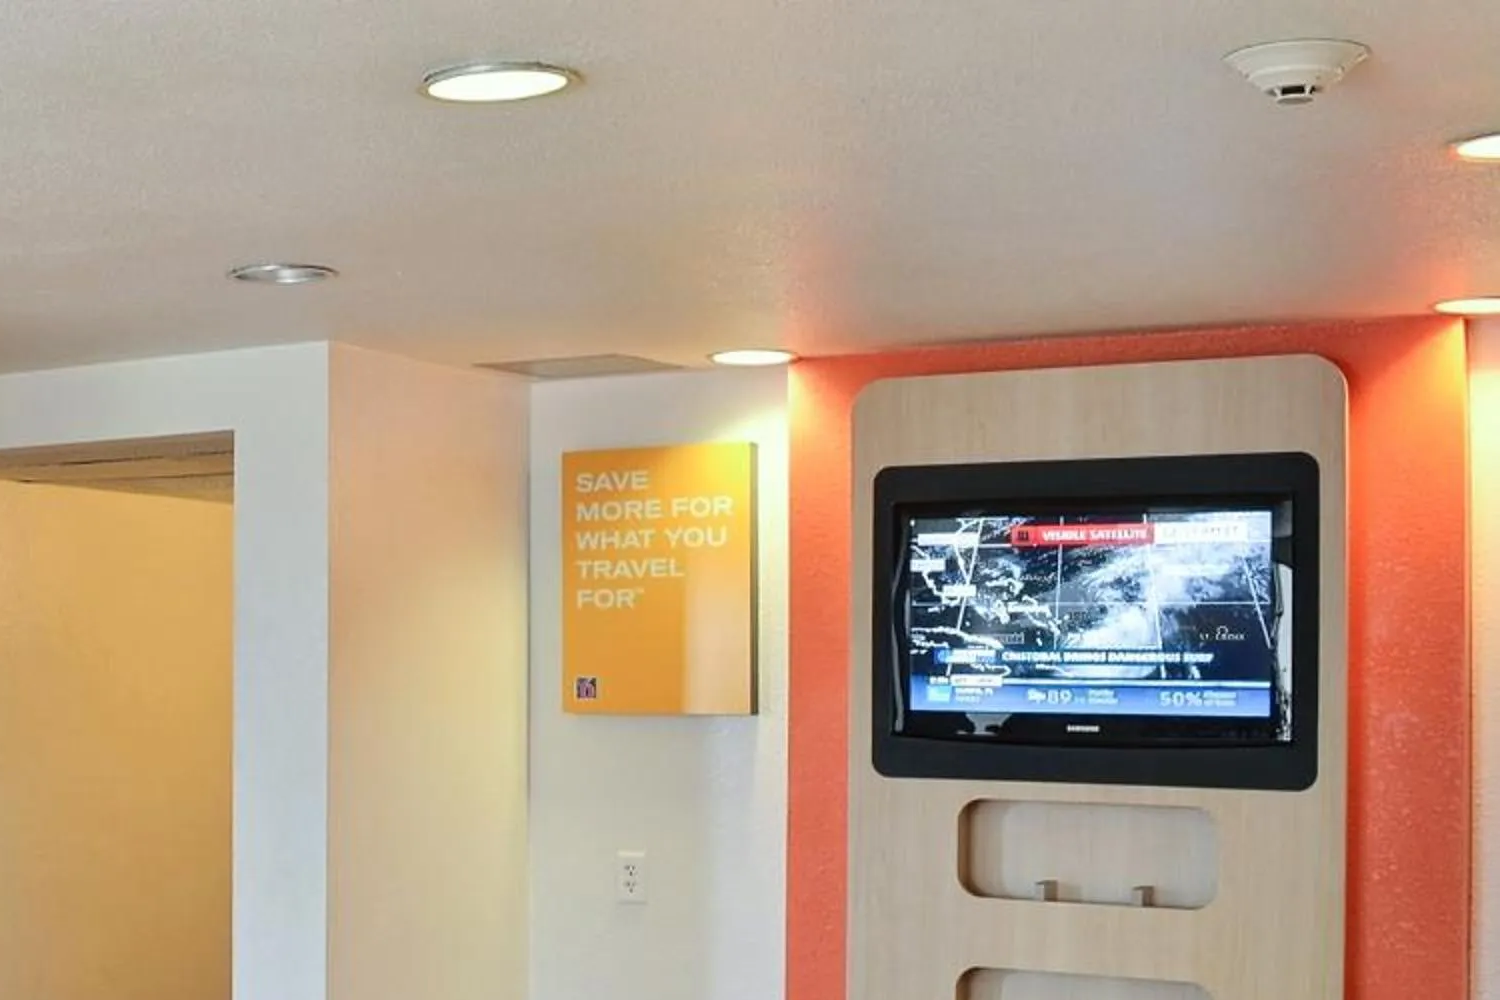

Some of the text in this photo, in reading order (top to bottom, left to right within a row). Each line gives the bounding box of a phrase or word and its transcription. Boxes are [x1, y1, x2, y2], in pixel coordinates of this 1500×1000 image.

[575, 470, 649, 493] SAVE
[575, 496, 734, 522] MORE FOR
[575, 526, 727, 550] WHAT YOU
[575, 558, 684, 580] TRAVEL
